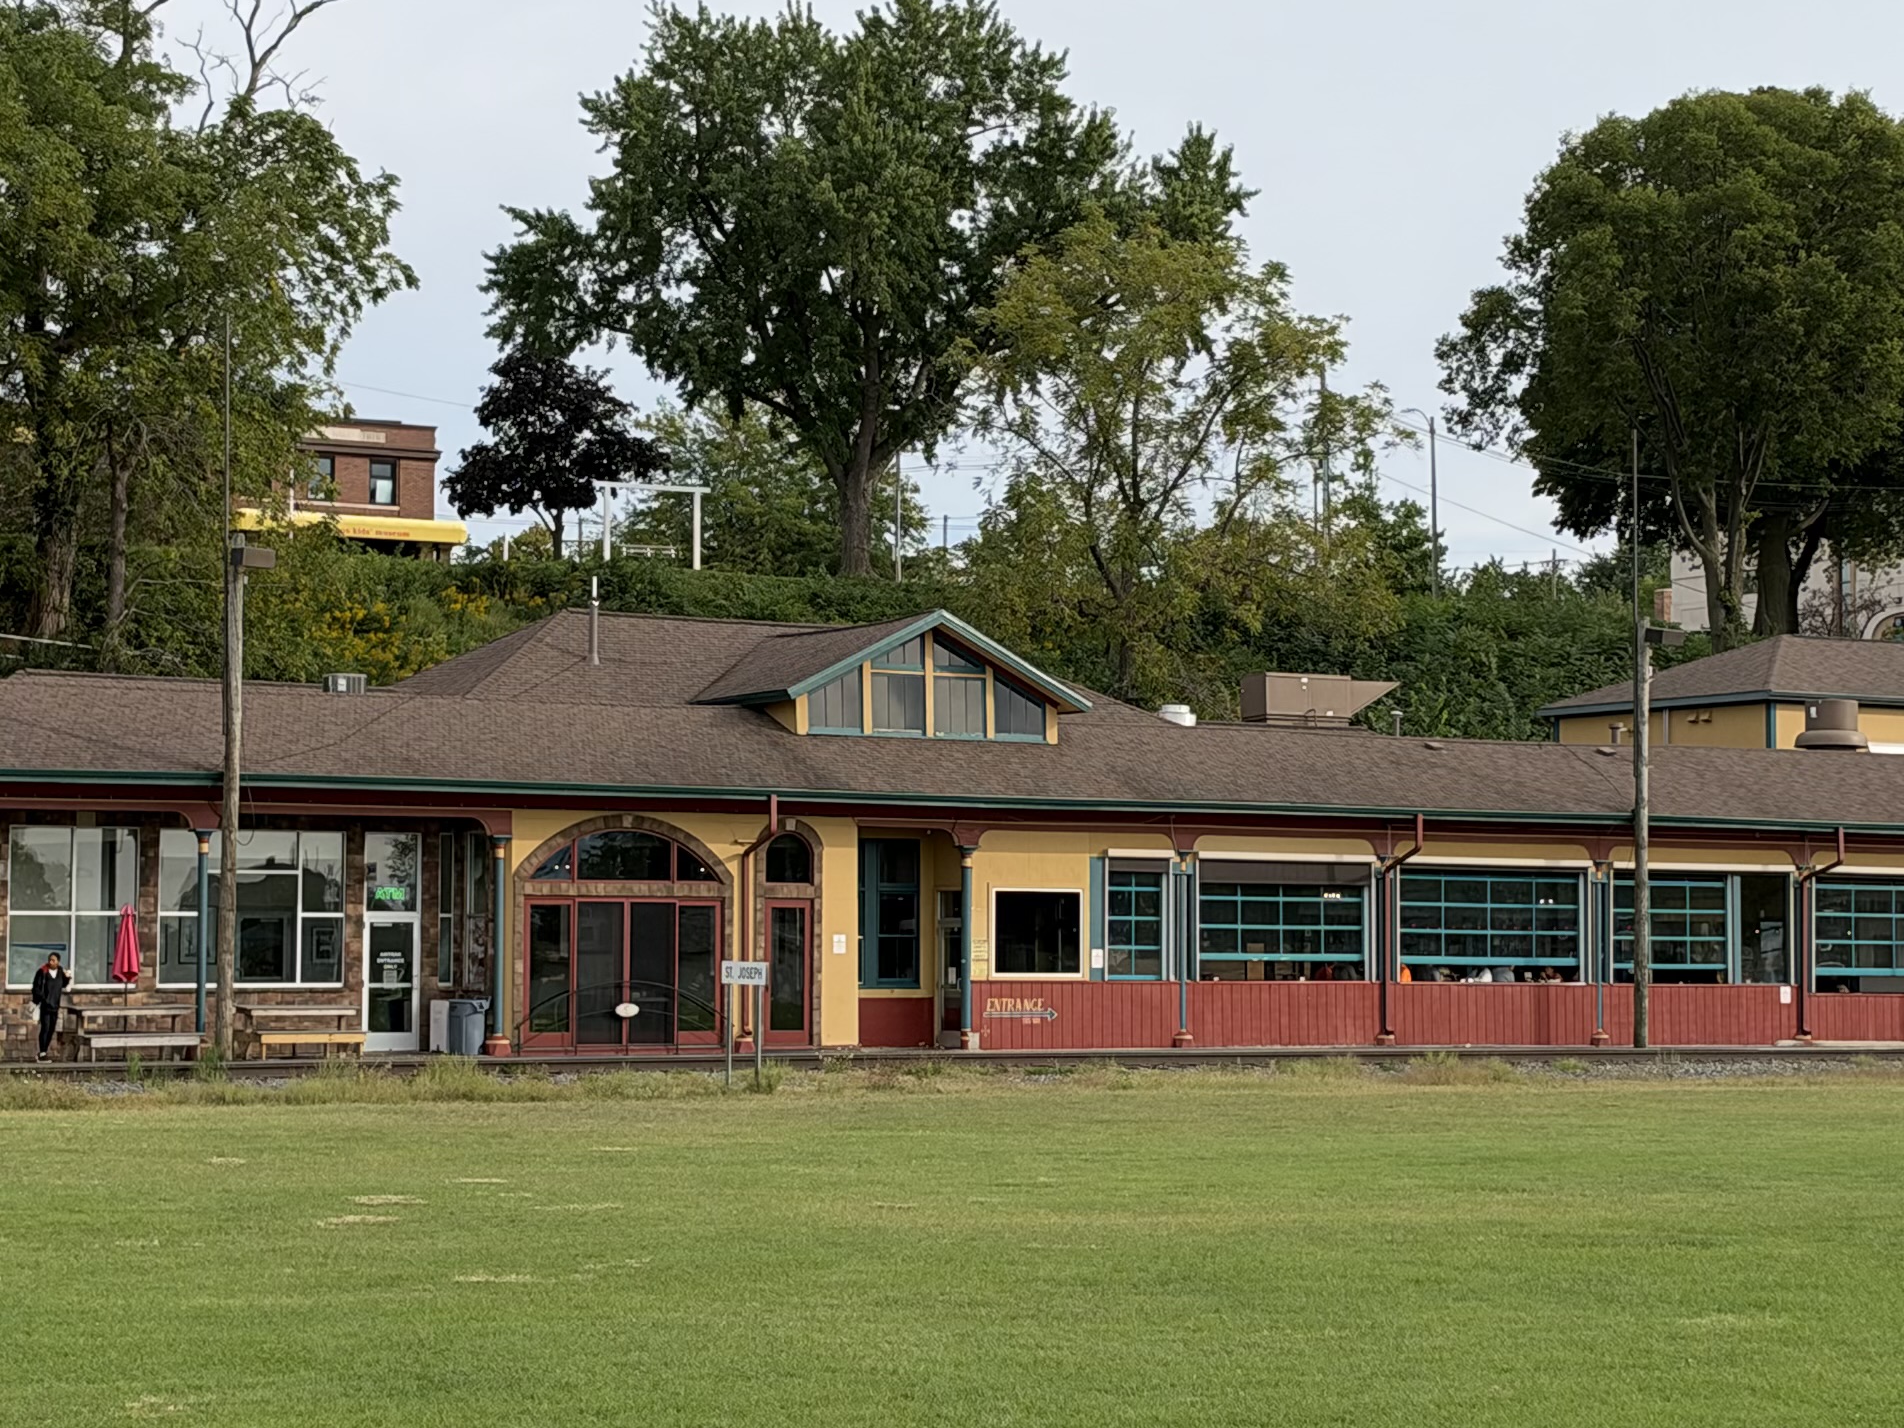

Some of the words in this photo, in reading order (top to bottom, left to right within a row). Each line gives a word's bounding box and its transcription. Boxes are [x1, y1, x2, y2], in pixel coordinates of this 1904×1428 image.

[375, 529, 410, 538] museum
[375, 886, 406, 901] ATM
[737, 966, 763, 980] JOSEPH
[986, 997, 1045, 1012] ENTRANCE
